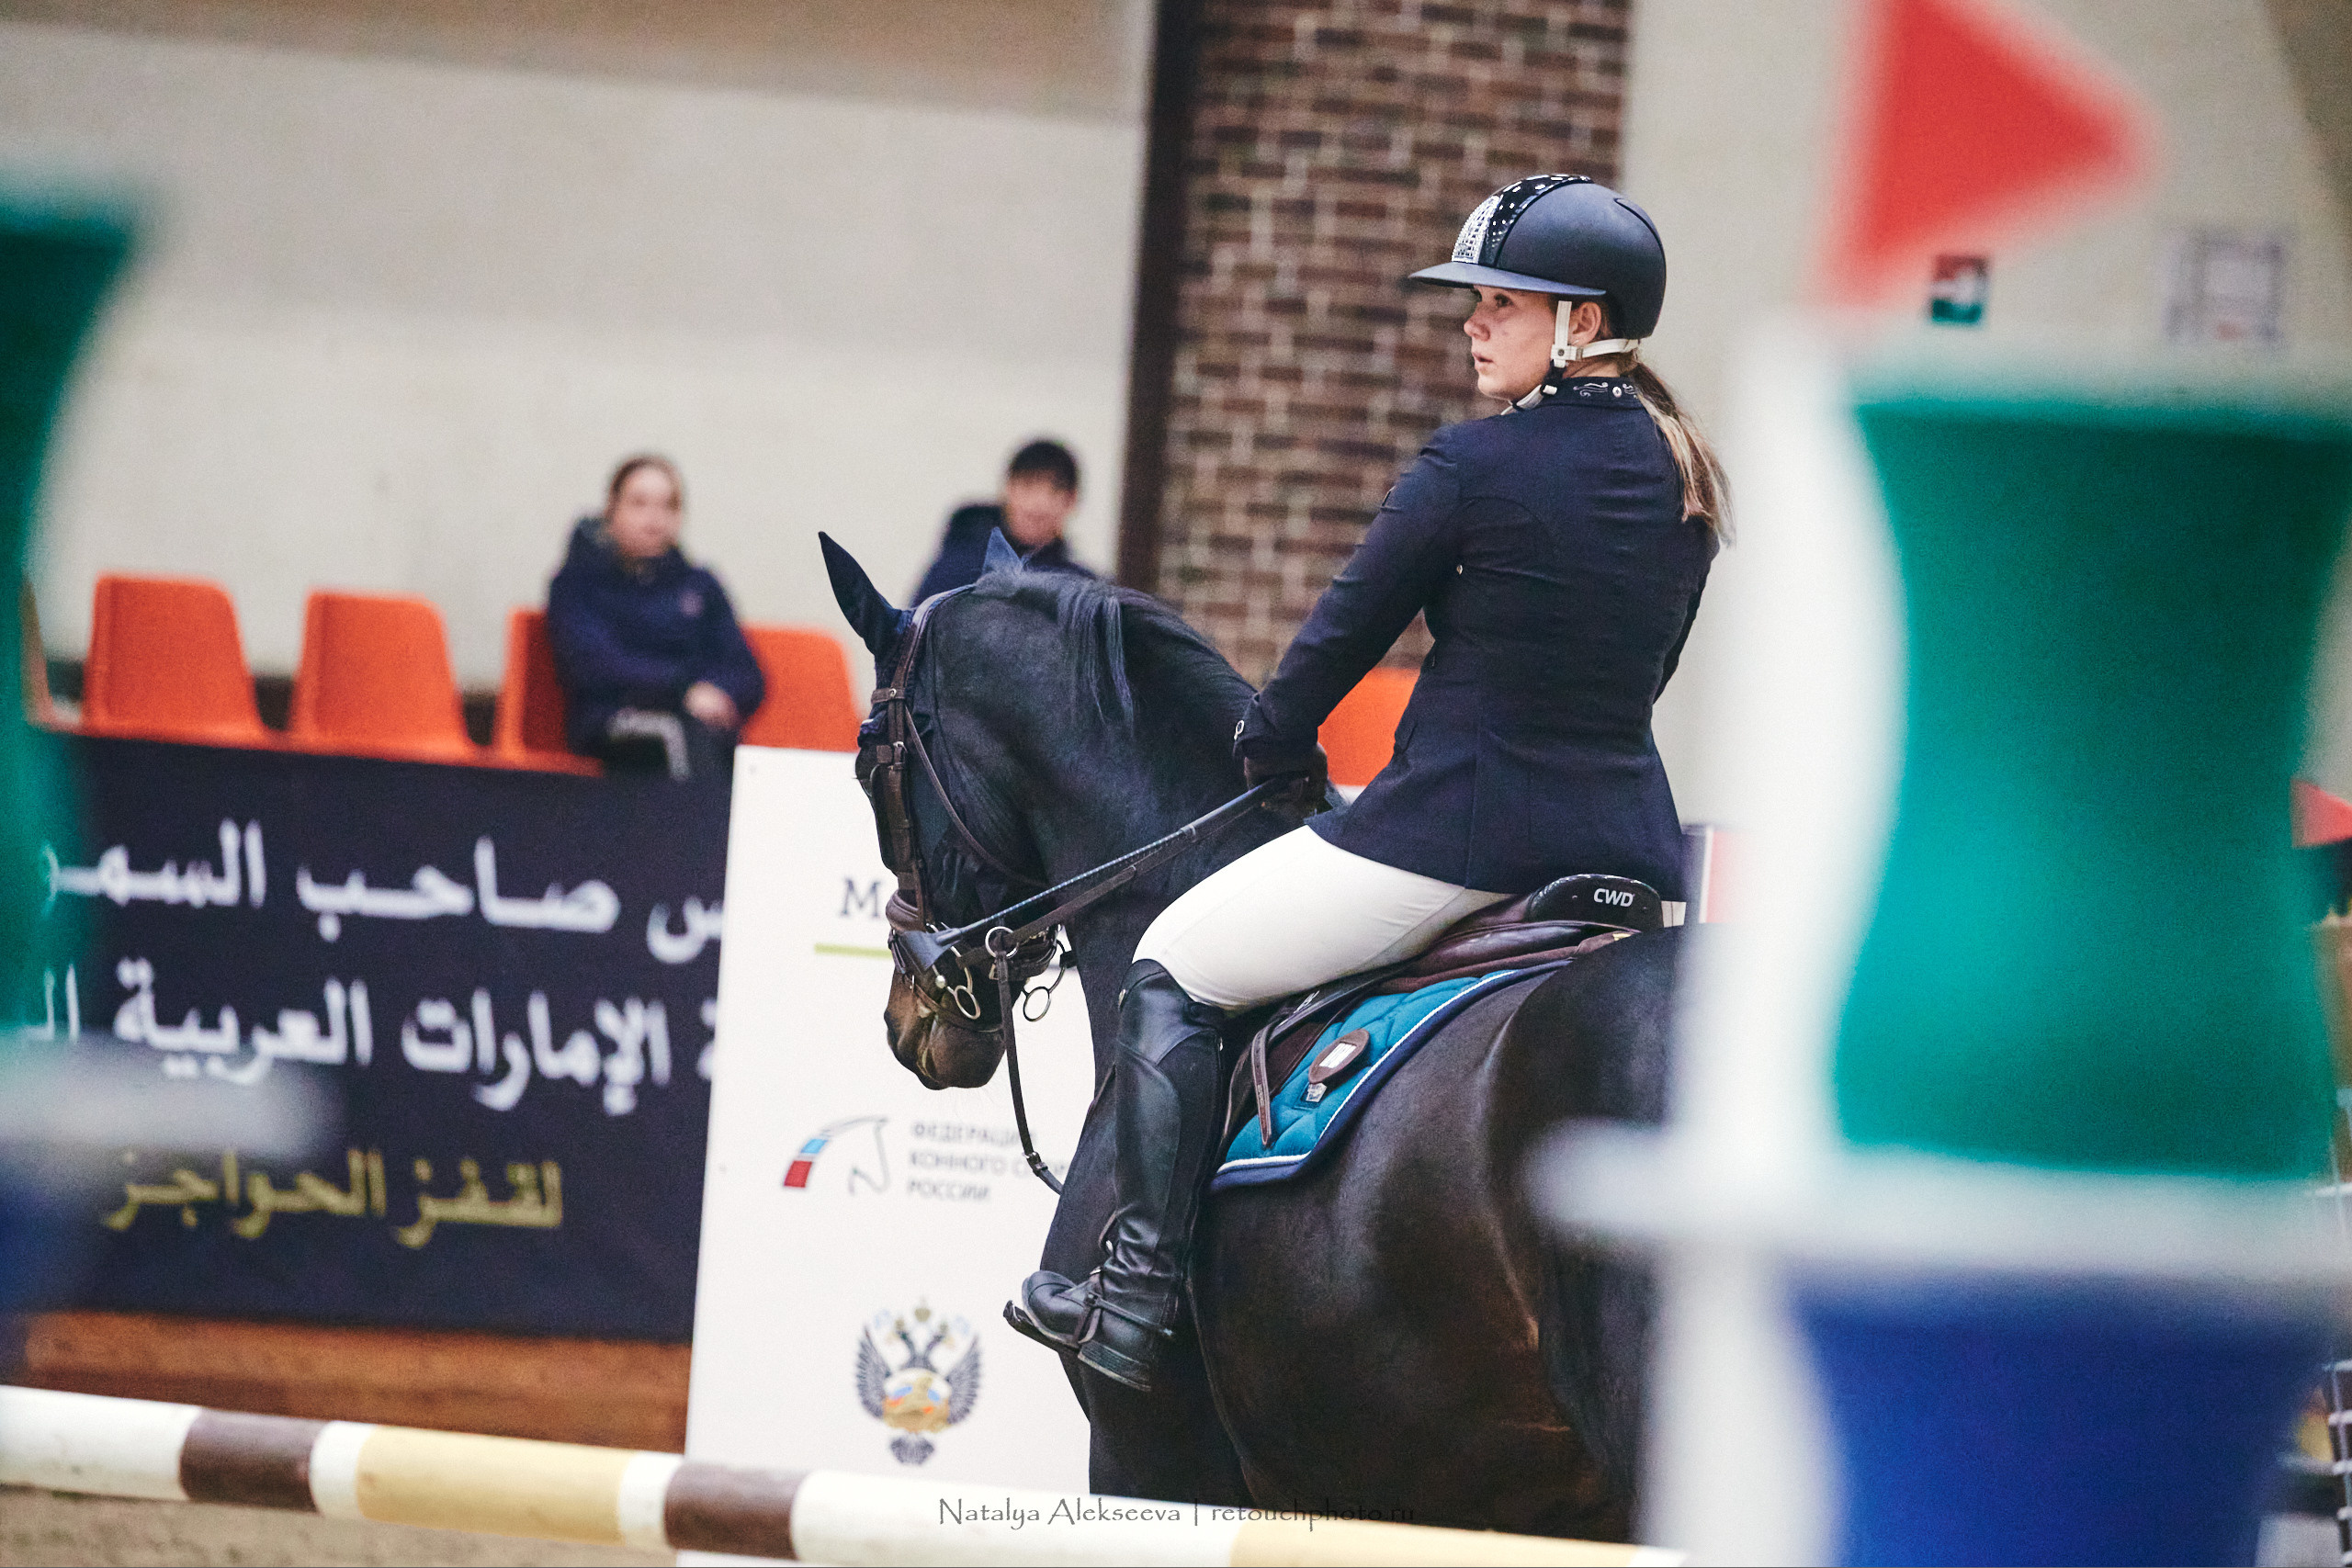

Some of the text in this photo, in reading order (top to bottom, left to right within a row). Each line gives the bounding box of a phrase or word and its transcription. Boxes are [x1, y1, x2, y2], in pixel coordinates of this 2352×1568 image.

[295, 834, 622, 942] صاحب
[1593, 887, 1634, 908] CWD
[112, 955, 373, 1086] العربية
[401, 987, 673, 1117] الإمارات
[99, 1147, 563, 1249] لقفز الحواجز
[907, 1176, 989, 1201] РОССИИ
